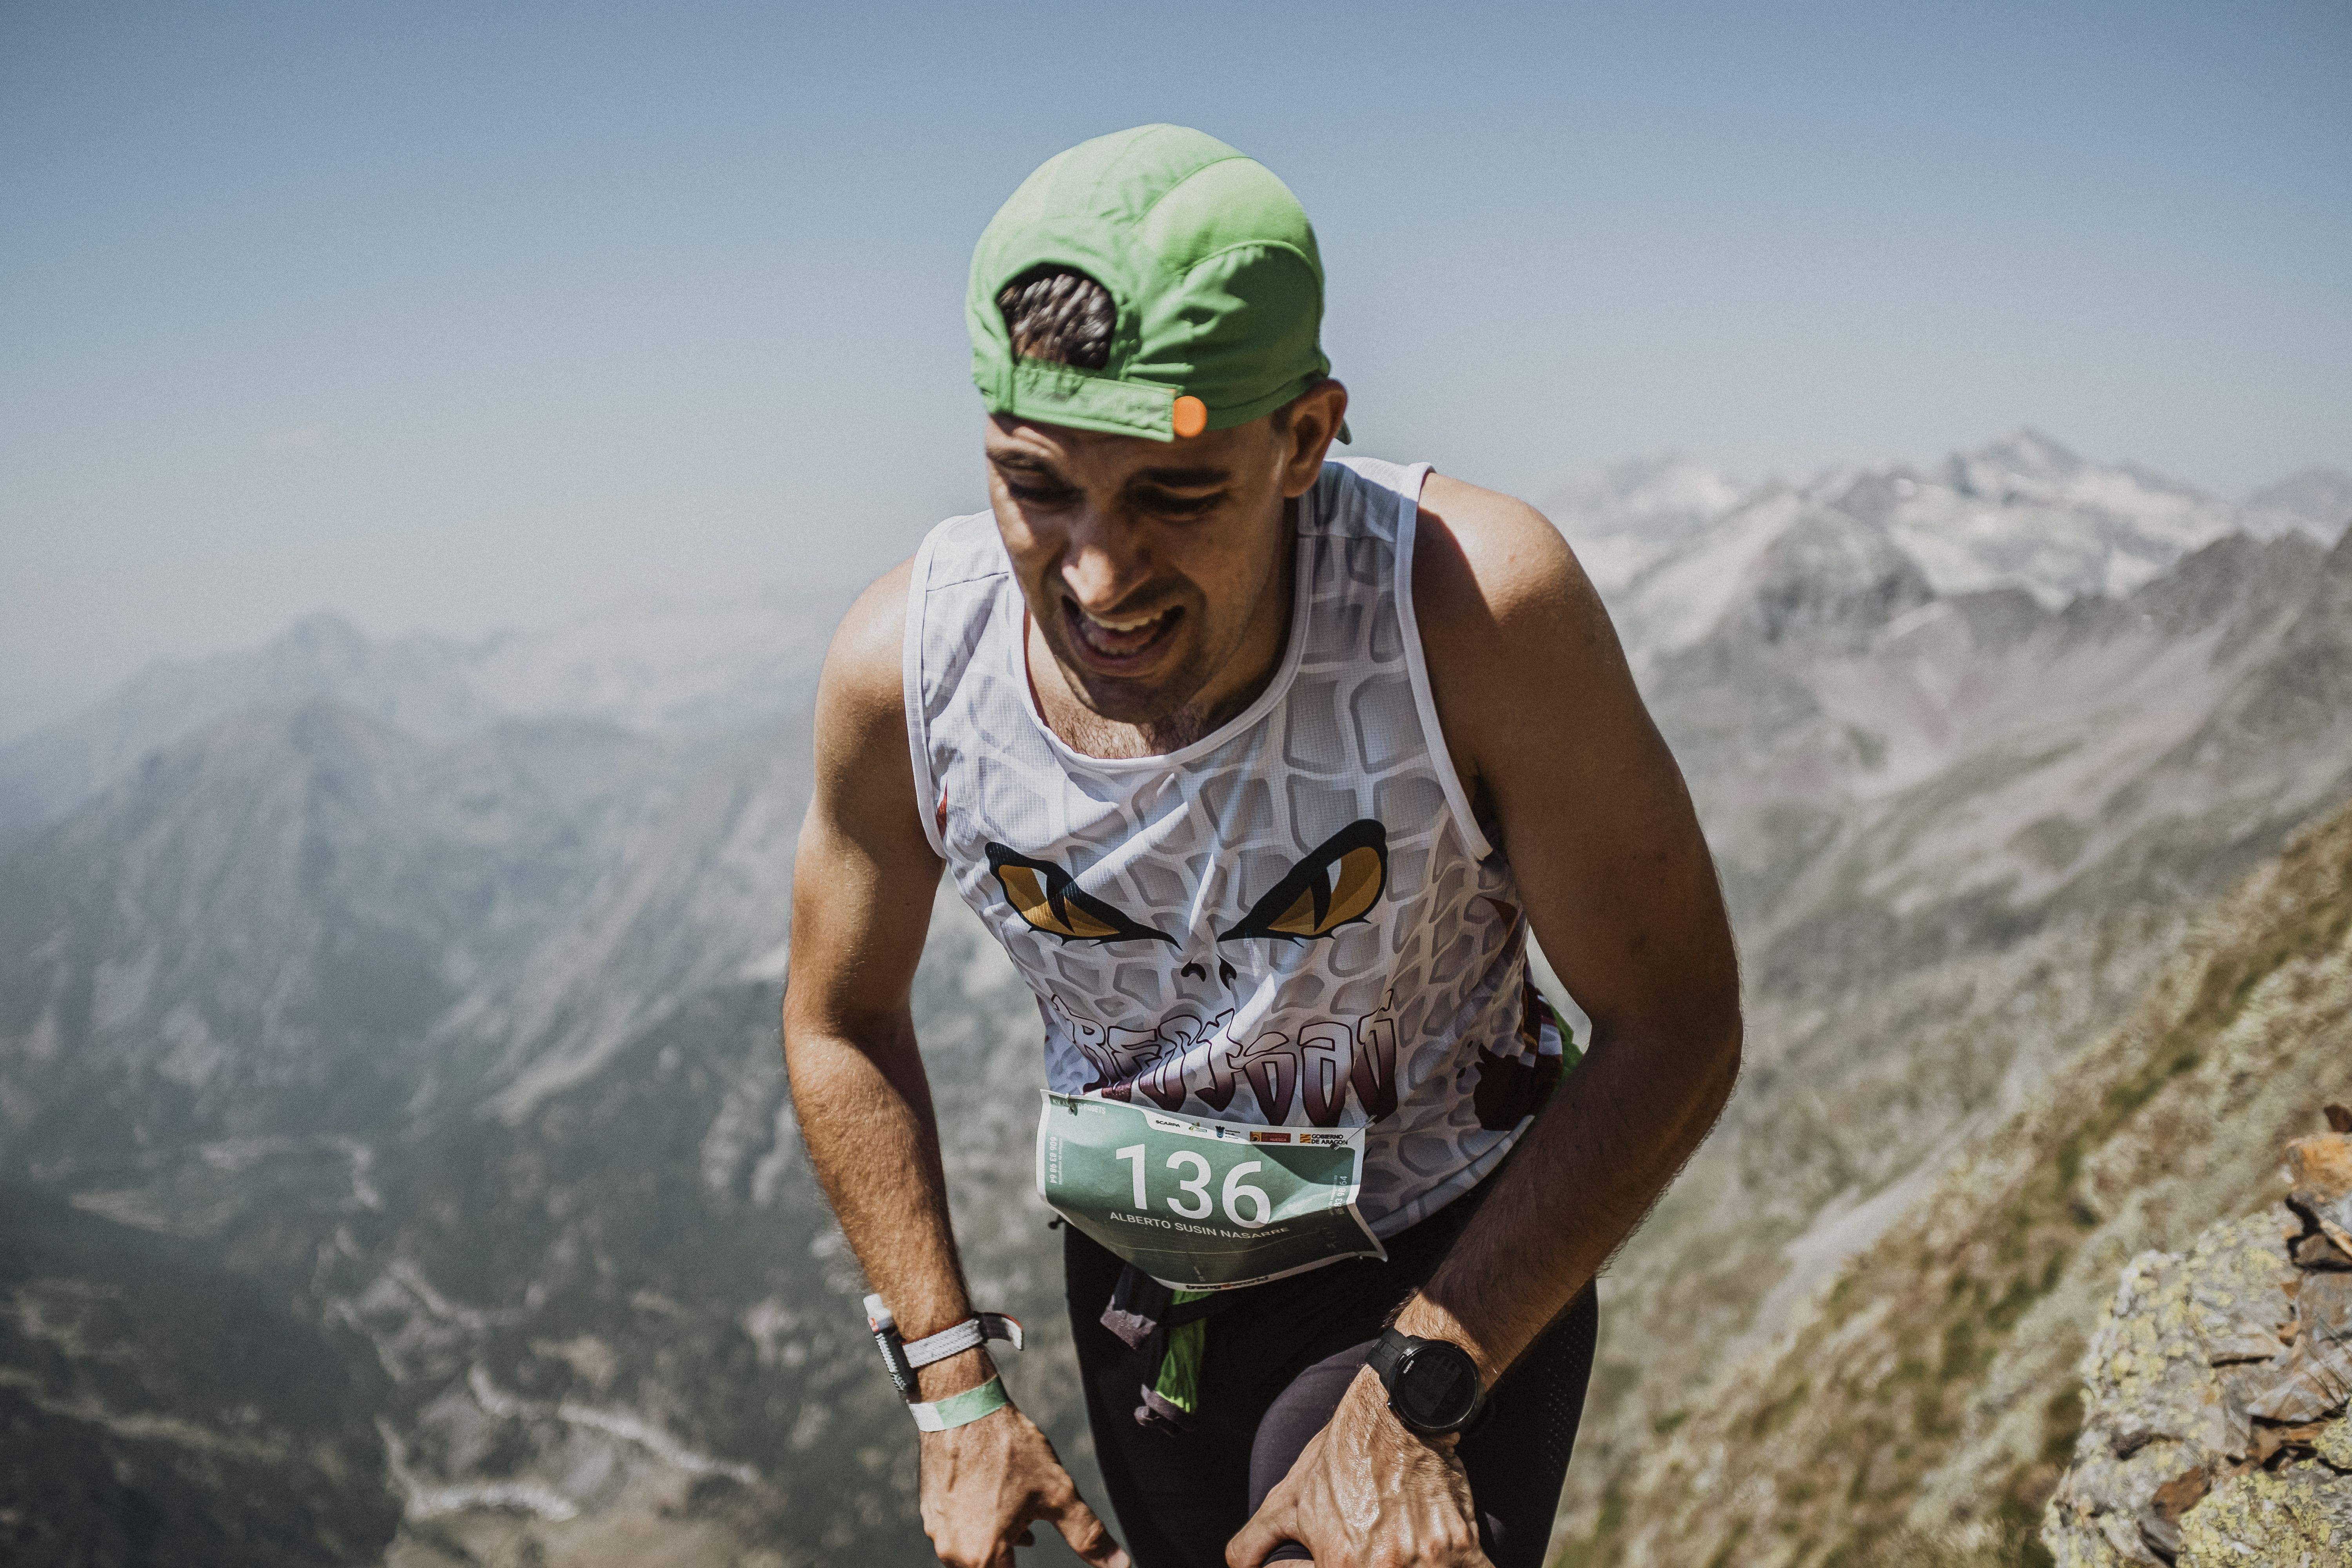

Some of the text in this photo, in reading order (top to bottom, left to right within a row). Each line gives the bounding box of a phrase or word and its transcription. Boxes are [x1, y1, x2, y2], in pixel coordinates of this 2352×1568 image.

[1339, 1176, 1348, 1185] 64
[1116, 1143, 1271, 1229] 136
[1337, 1188, 1346, 1197] 98
[1334, 1198, 1343, 1207] 83
[1110, 1212, 1290, 1239] ALBERTO SUSIN NASARRE
